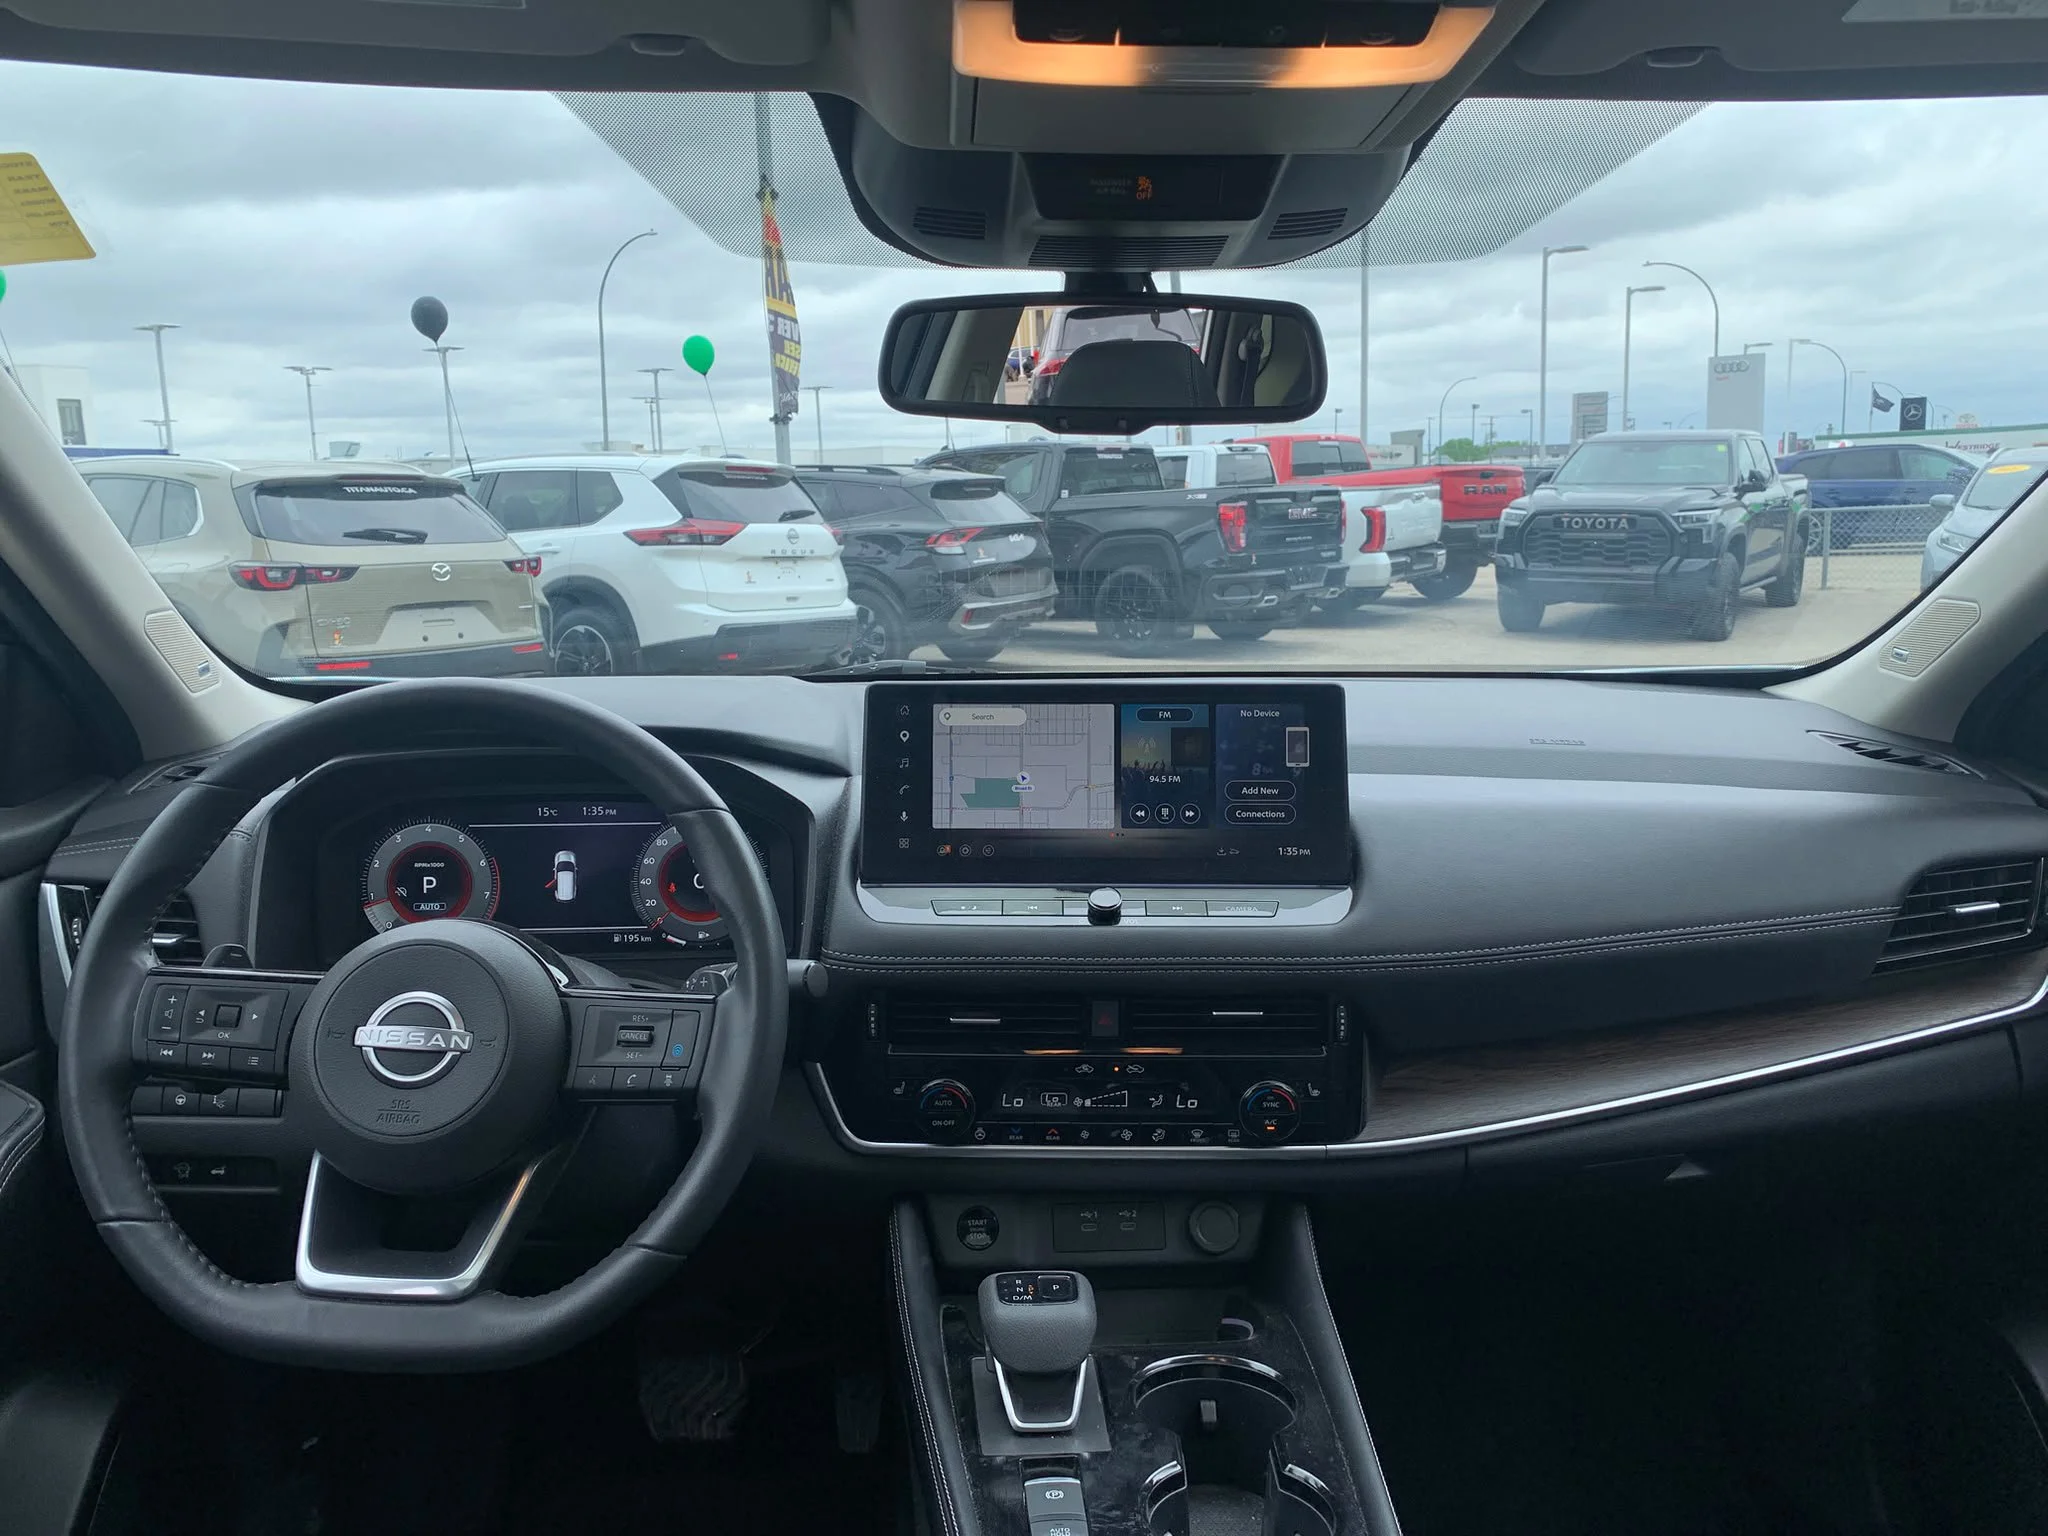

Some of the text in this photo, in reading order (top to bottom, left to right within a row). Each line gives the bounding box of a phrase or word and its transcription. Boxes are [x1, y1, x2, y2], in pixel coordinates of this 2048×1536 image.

[1464, 484, 1507, 495] RAM
[1561, 516, 1629, 530] TOYOTA
[971, 713, 996, 721] Search
[1158, 711, 1172, 720] FM
[1240, 709, 1281, 718] No Device
[1149, 775, 1182, 784] 94.5 FM
[1241, 786, 1280, 796] Add New
[582, 806, 617, 816] 1:35 PM
[1235, 809, 1287, 819] Connections
[395, 834, 402, 843] 3
[458, 834, 465, 843] 5
[655, 838, 669, 847] 80
[1278, 846, 1312, 856] 1:35 PM
[373, 859, 380, 868] 2
[479, 858, 487, 867] 6
[643, 856, 656, 865] 60
[422, 875, 438, 894] P
[640, 877, 652, 886] 40
[483, 891, 491, 900] 7
[419, 902, 441, 912] AUTO
[645, 898, 657, 907] 20
[623, 934, 652, 943] 195 km
[217, 1031, 230, 1039] OK
[620, 1031, 648, 1041] CANCEL
[356, 1029, 471, 1051] NISSAN
[390, 1099, 411, 1110] SRS
[933, 1099, 953, 1107] AUTO
[1002, 1093, 1024, 1108] Lo
[1176, 1094, 1198, 1109] Lo
[1262, 1101, 1280, 1109] SYNC
[375, 1112, 421, 1125] AIRBAG
[967, 1218, 988, 1227] START
